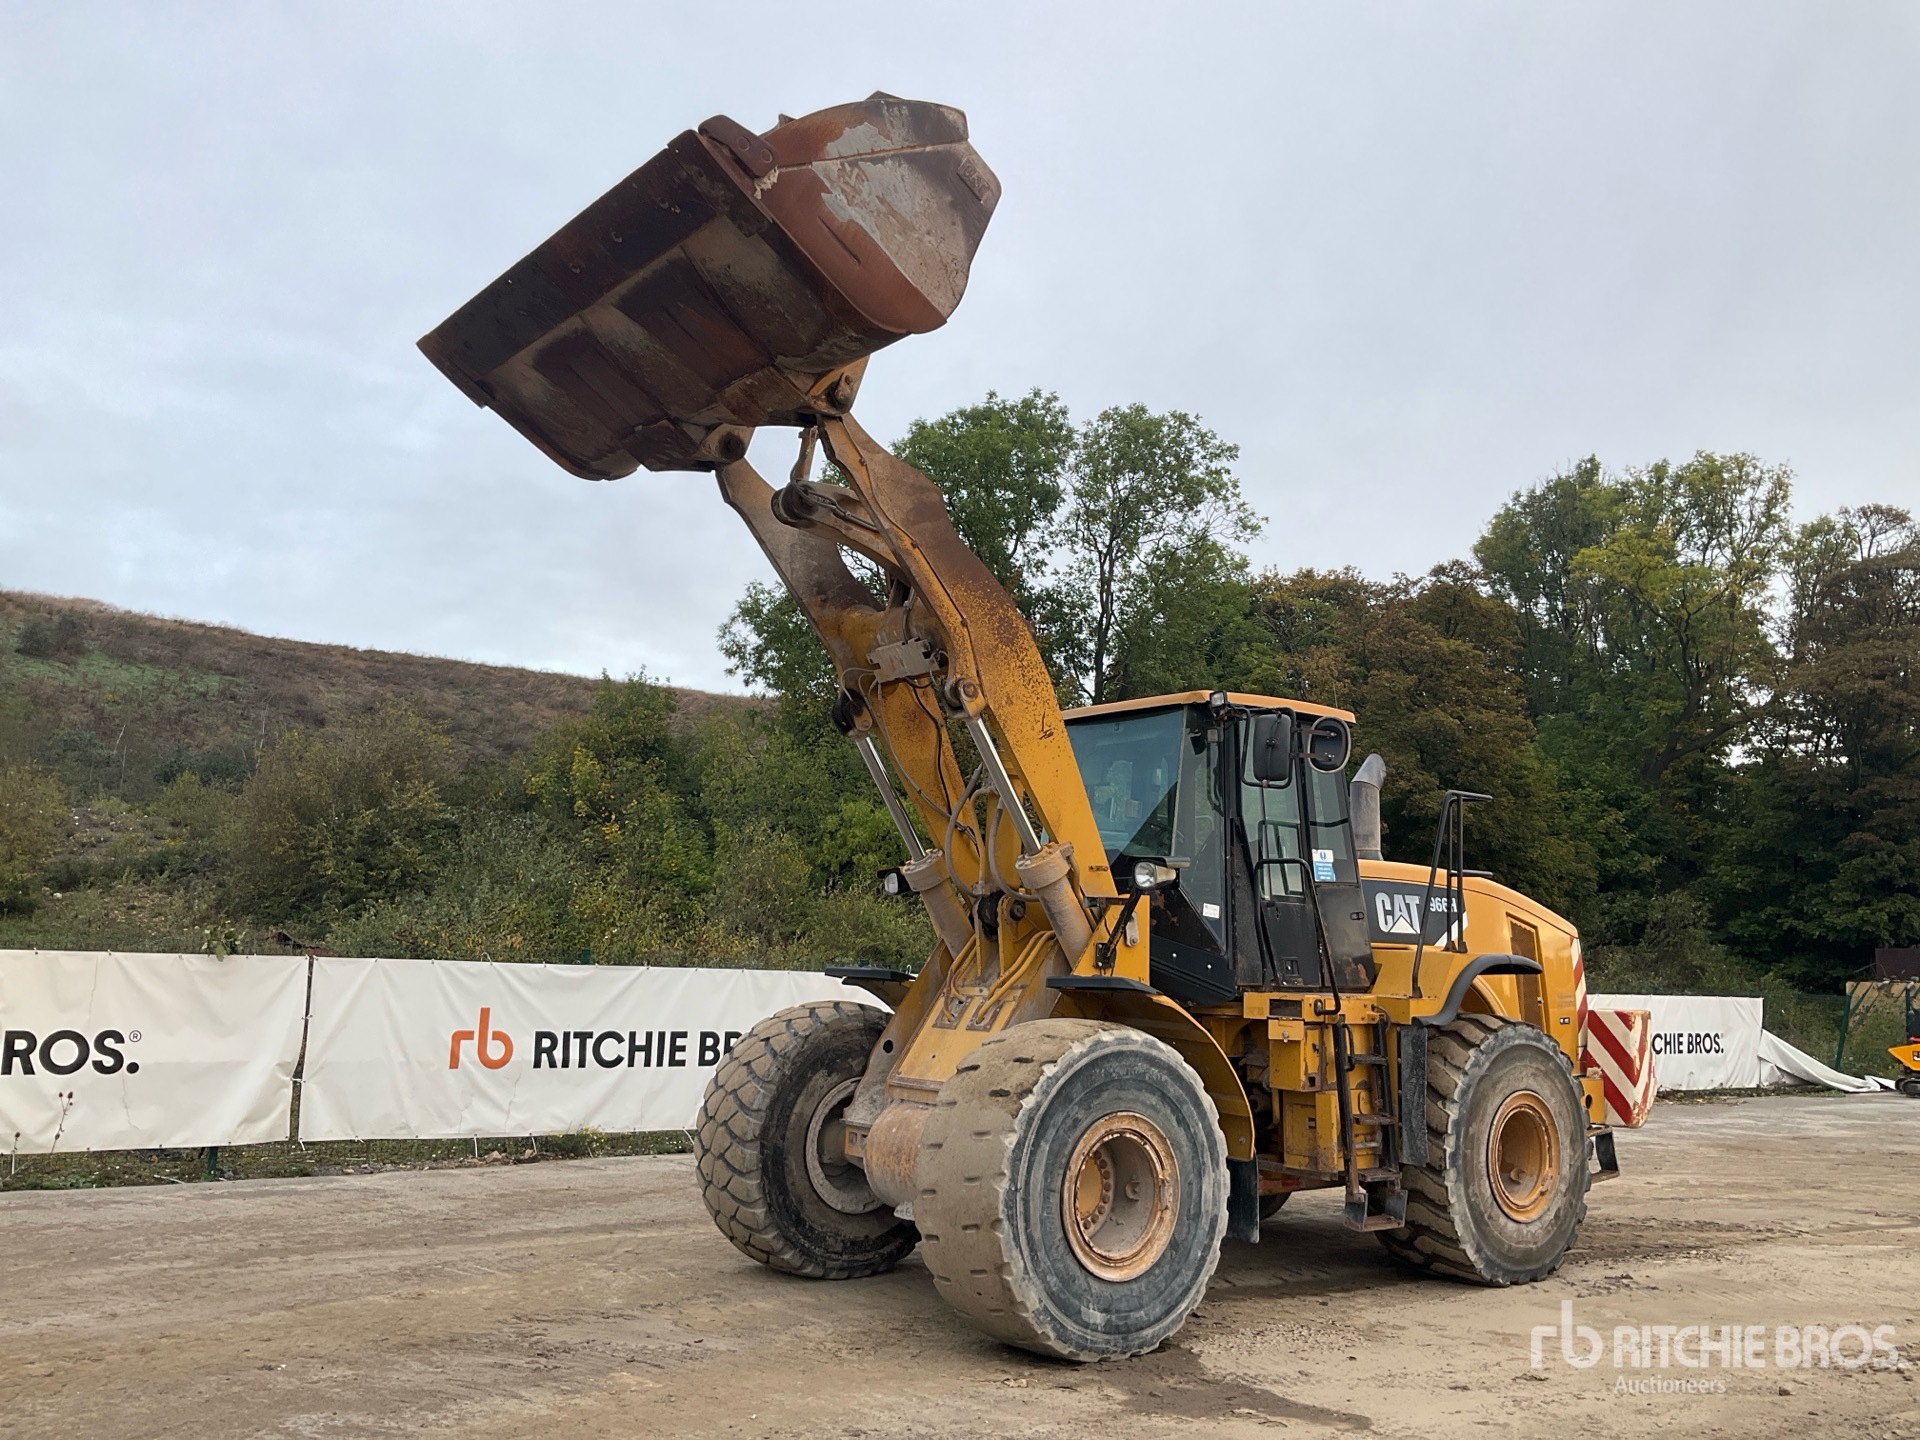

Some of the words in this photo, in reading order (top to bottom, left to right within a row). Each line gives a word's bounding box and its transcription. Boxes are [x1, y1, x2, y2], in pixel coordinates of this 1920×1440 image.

[1375, 892, 1420, 934] CAT
[449, 1007, 513, 1070] rb
[533, 1030, 688, 1069] RITCHIE
[1651, 1032, 1683, 1055] CHIE
